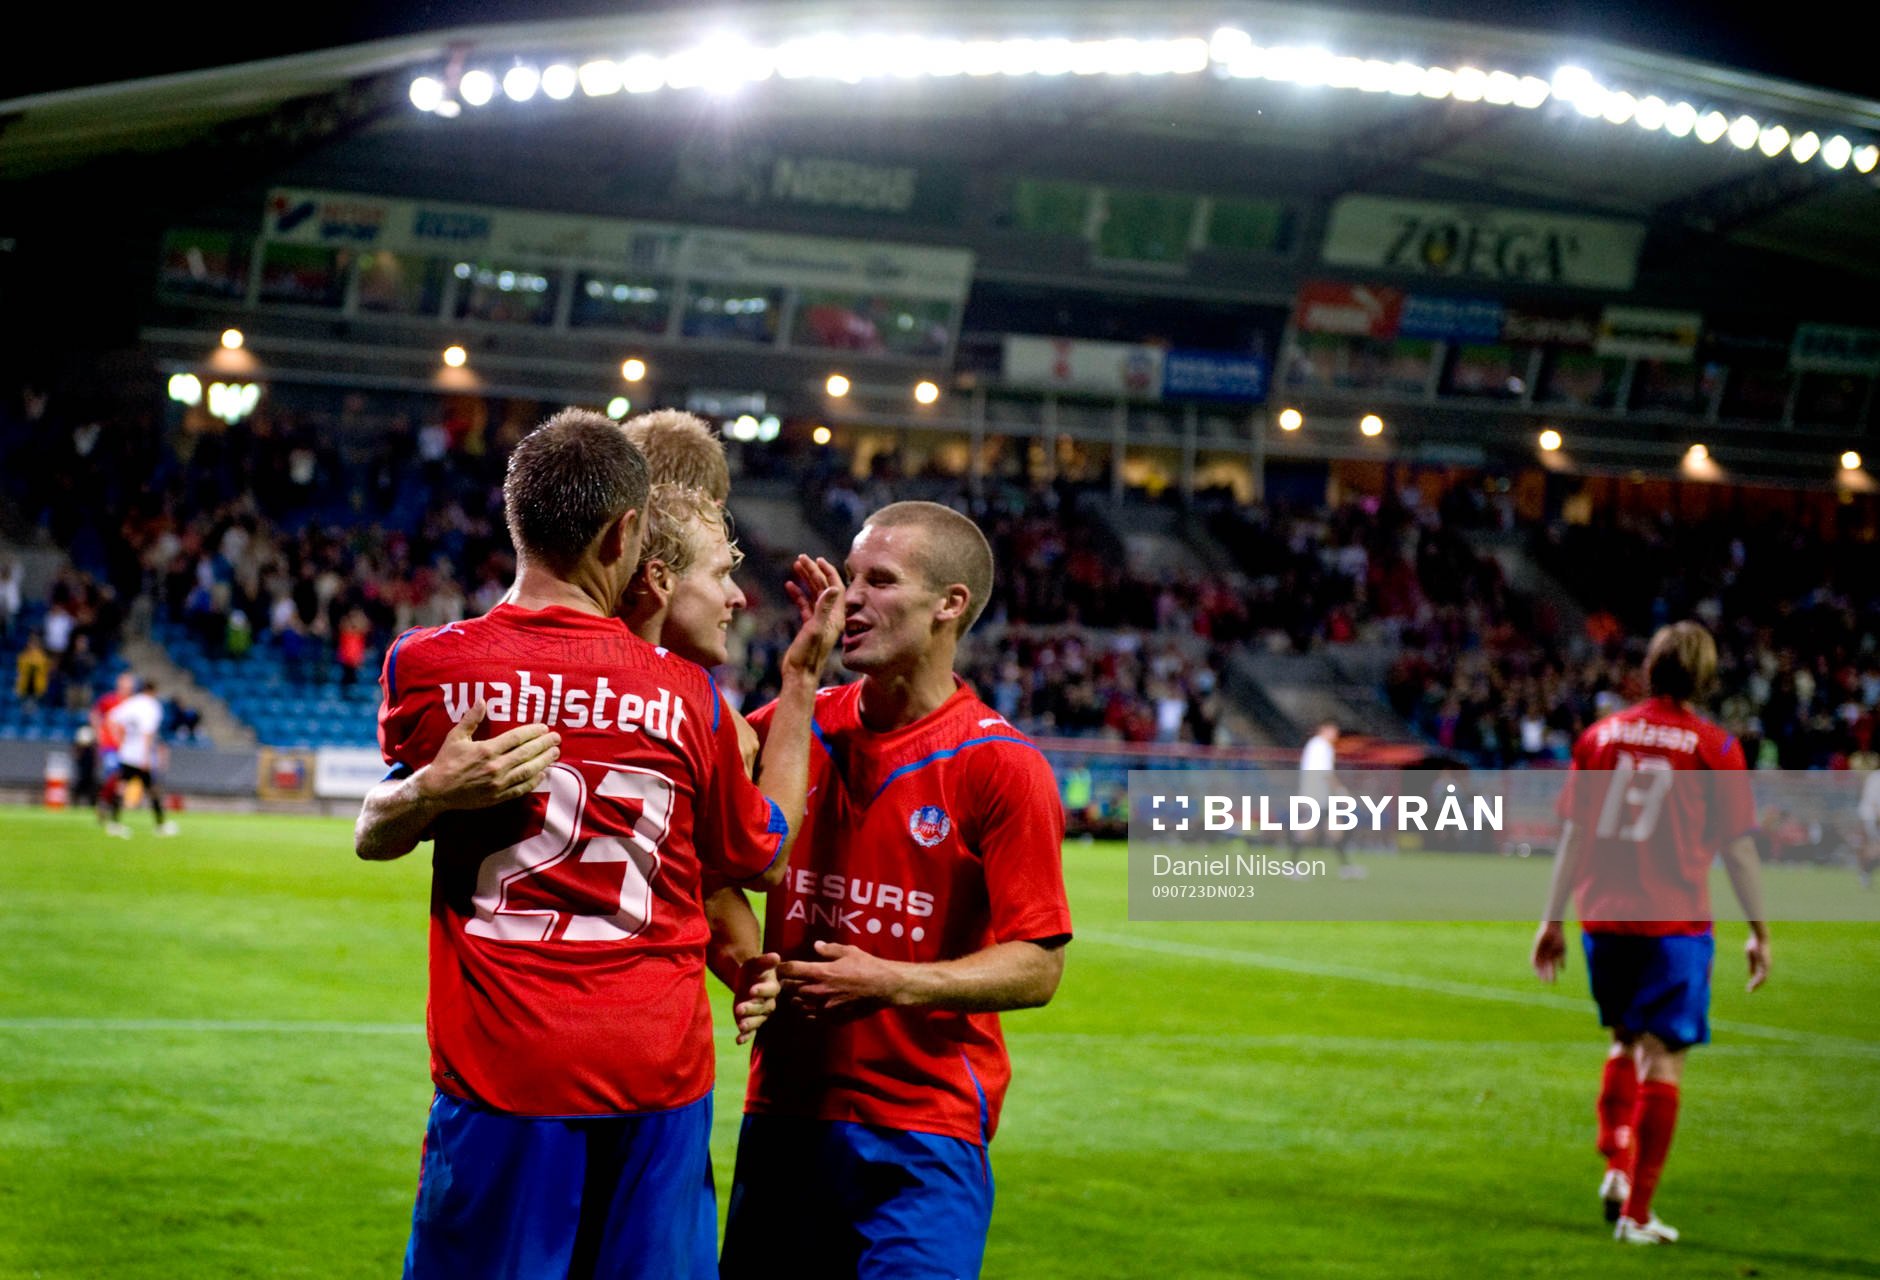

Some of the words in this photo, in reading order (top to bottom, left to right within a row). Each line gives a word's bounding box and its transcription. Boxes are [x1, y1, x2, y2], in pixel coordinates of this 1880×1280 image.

[439, 670, 687, 747] wahlstedt
[1596, 750, 1674, 842] 13
[464, 760, 676, 942] 23
[786, 899, 864, 934] ANK
